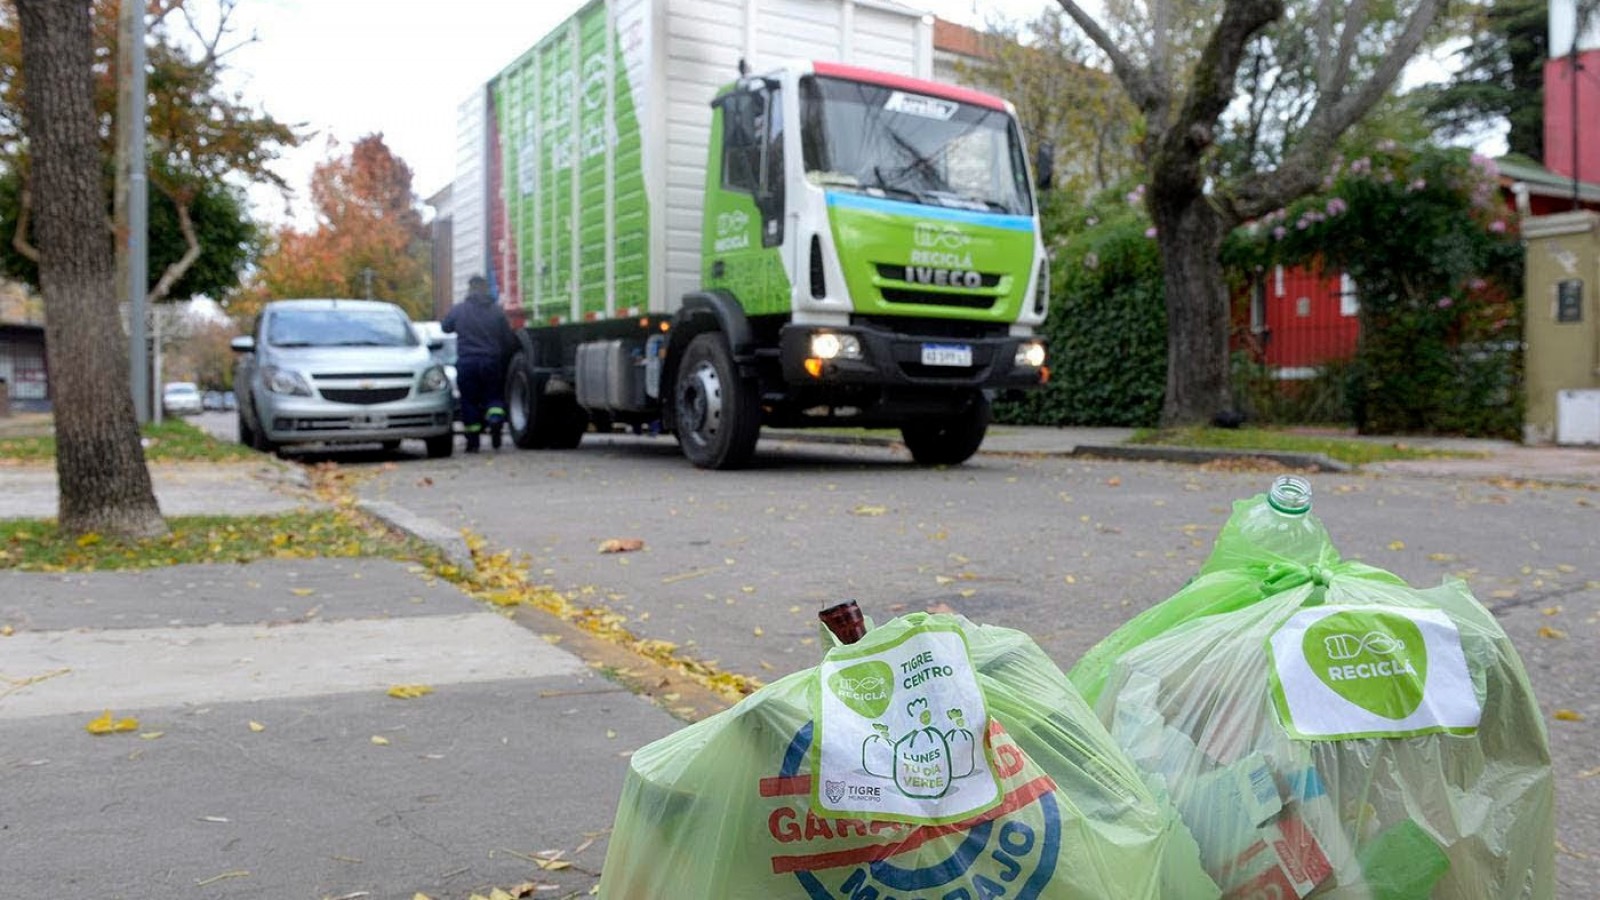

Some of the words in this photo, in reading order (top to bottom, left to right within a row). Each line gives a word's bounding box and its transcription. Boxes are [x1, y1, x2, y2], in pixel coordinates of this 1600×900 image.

[905, 266, 982, 288] IVECO
[901, 651, 934, 674] TIGRE
[1328, 658, 1418, 680] RECICLÁ
[903, 665, 953, 690] CENTRO
[903, 748, 941, 763] LUNES
[847, 785, 881, 796] TIGRE
[903, 776, 944, 788] VERDE
